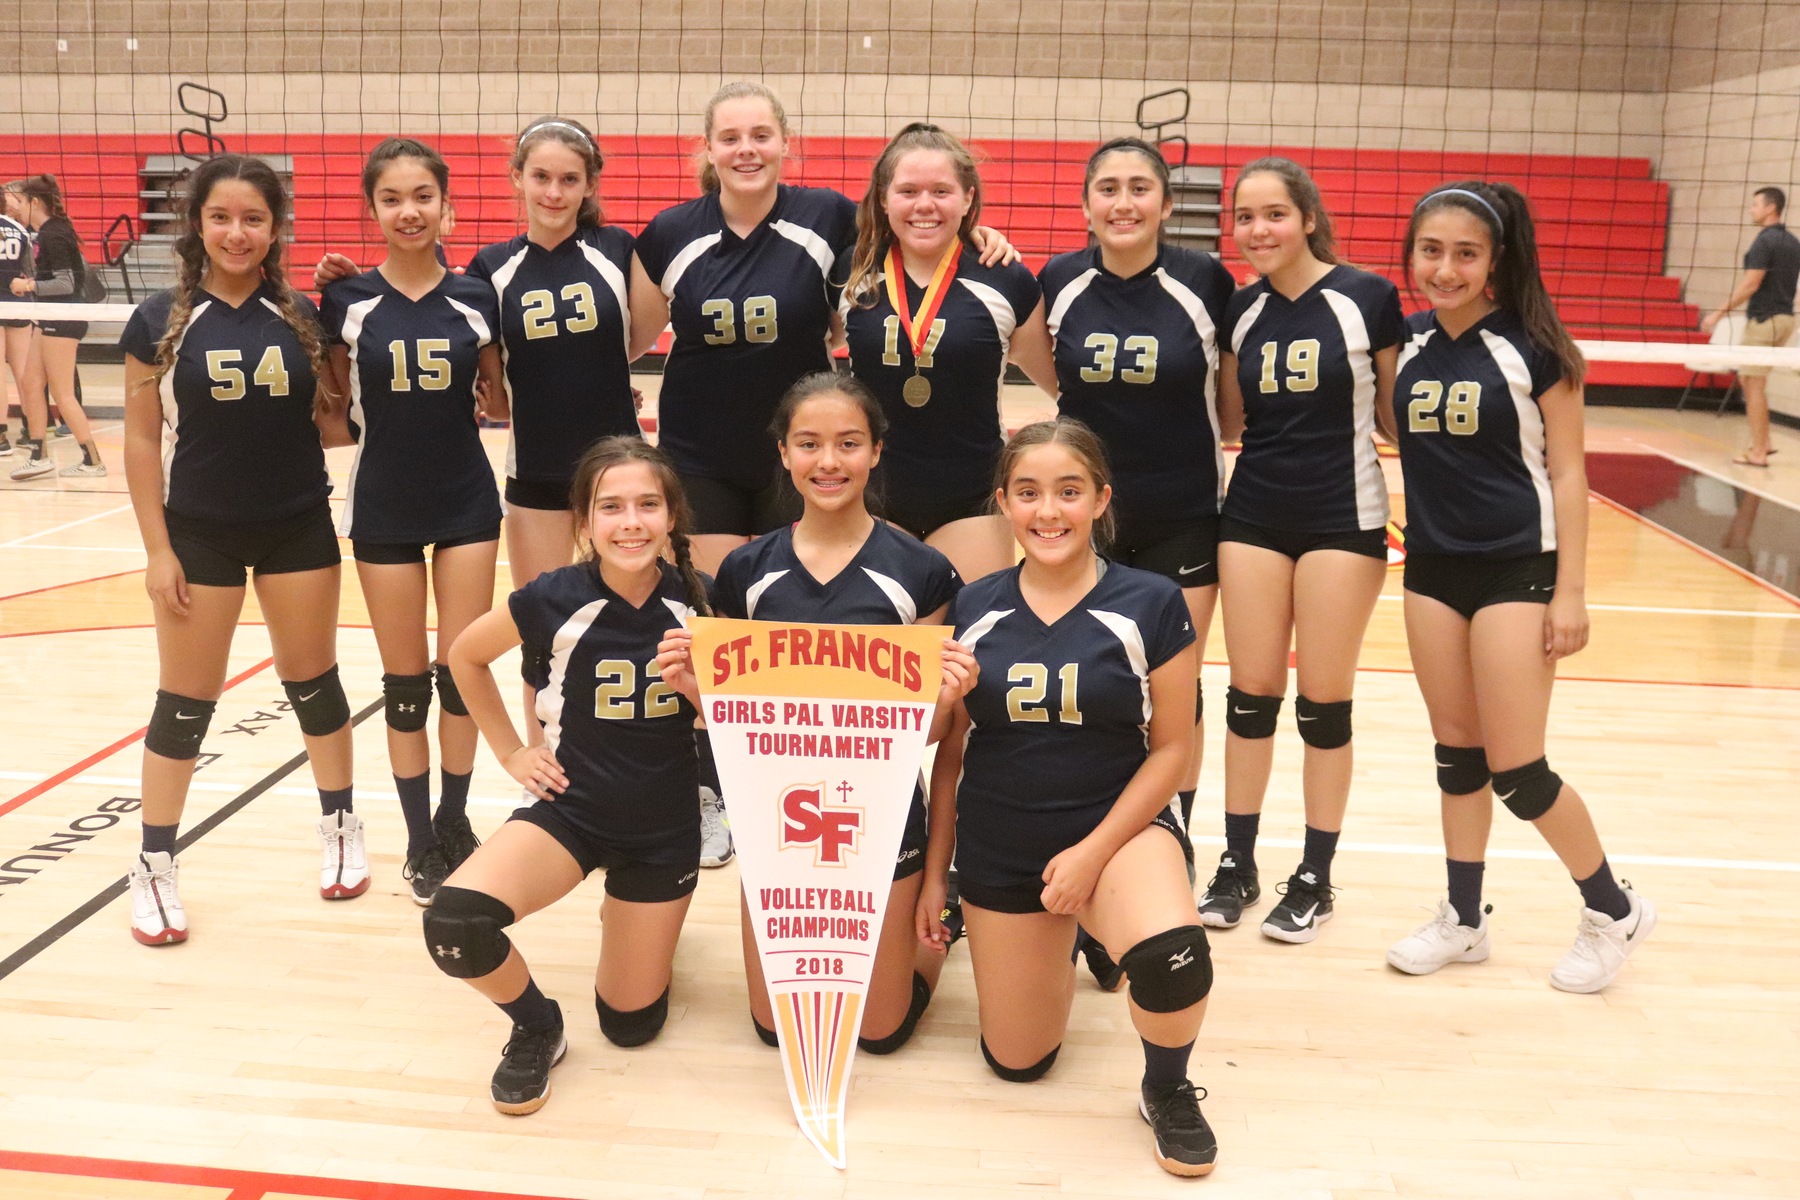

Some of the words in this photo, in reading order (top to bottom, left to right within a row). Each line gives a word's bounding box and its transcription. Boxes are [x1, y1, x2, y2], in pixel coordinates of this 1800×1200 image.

[521, 281, 598, 341] 23
[701, 294, 778, 344] 38
[388, 338, 452, 392] 15
[882, 314, 947, 368] 17
[1080, 332, 1159, 384] 33
[1259, 338, 1321, 394] 19
[205, 345, 290, 401] 54
[1408, 379, 1482, 436] 28
[712, 634, 760, 688] ST.
[768, 628, 923, 693] FRANCIS
[594, 658, 681, 720] 22
[712, 700, 776, 725] GIRLS
[783, 702, 824, 727] PAL
[831, 704, 926, 732] VARSITY
[1006, 662, 1083, 726] 21
[746, 732, 893, 761] TOURNAMENT
[783, 788, 860, 863] SF
[760, 887, 876, 915] VOLLEYBALL
[767, 916, 870, 942] CHAMPIONS
[795, 957, 844, 976] 2018
